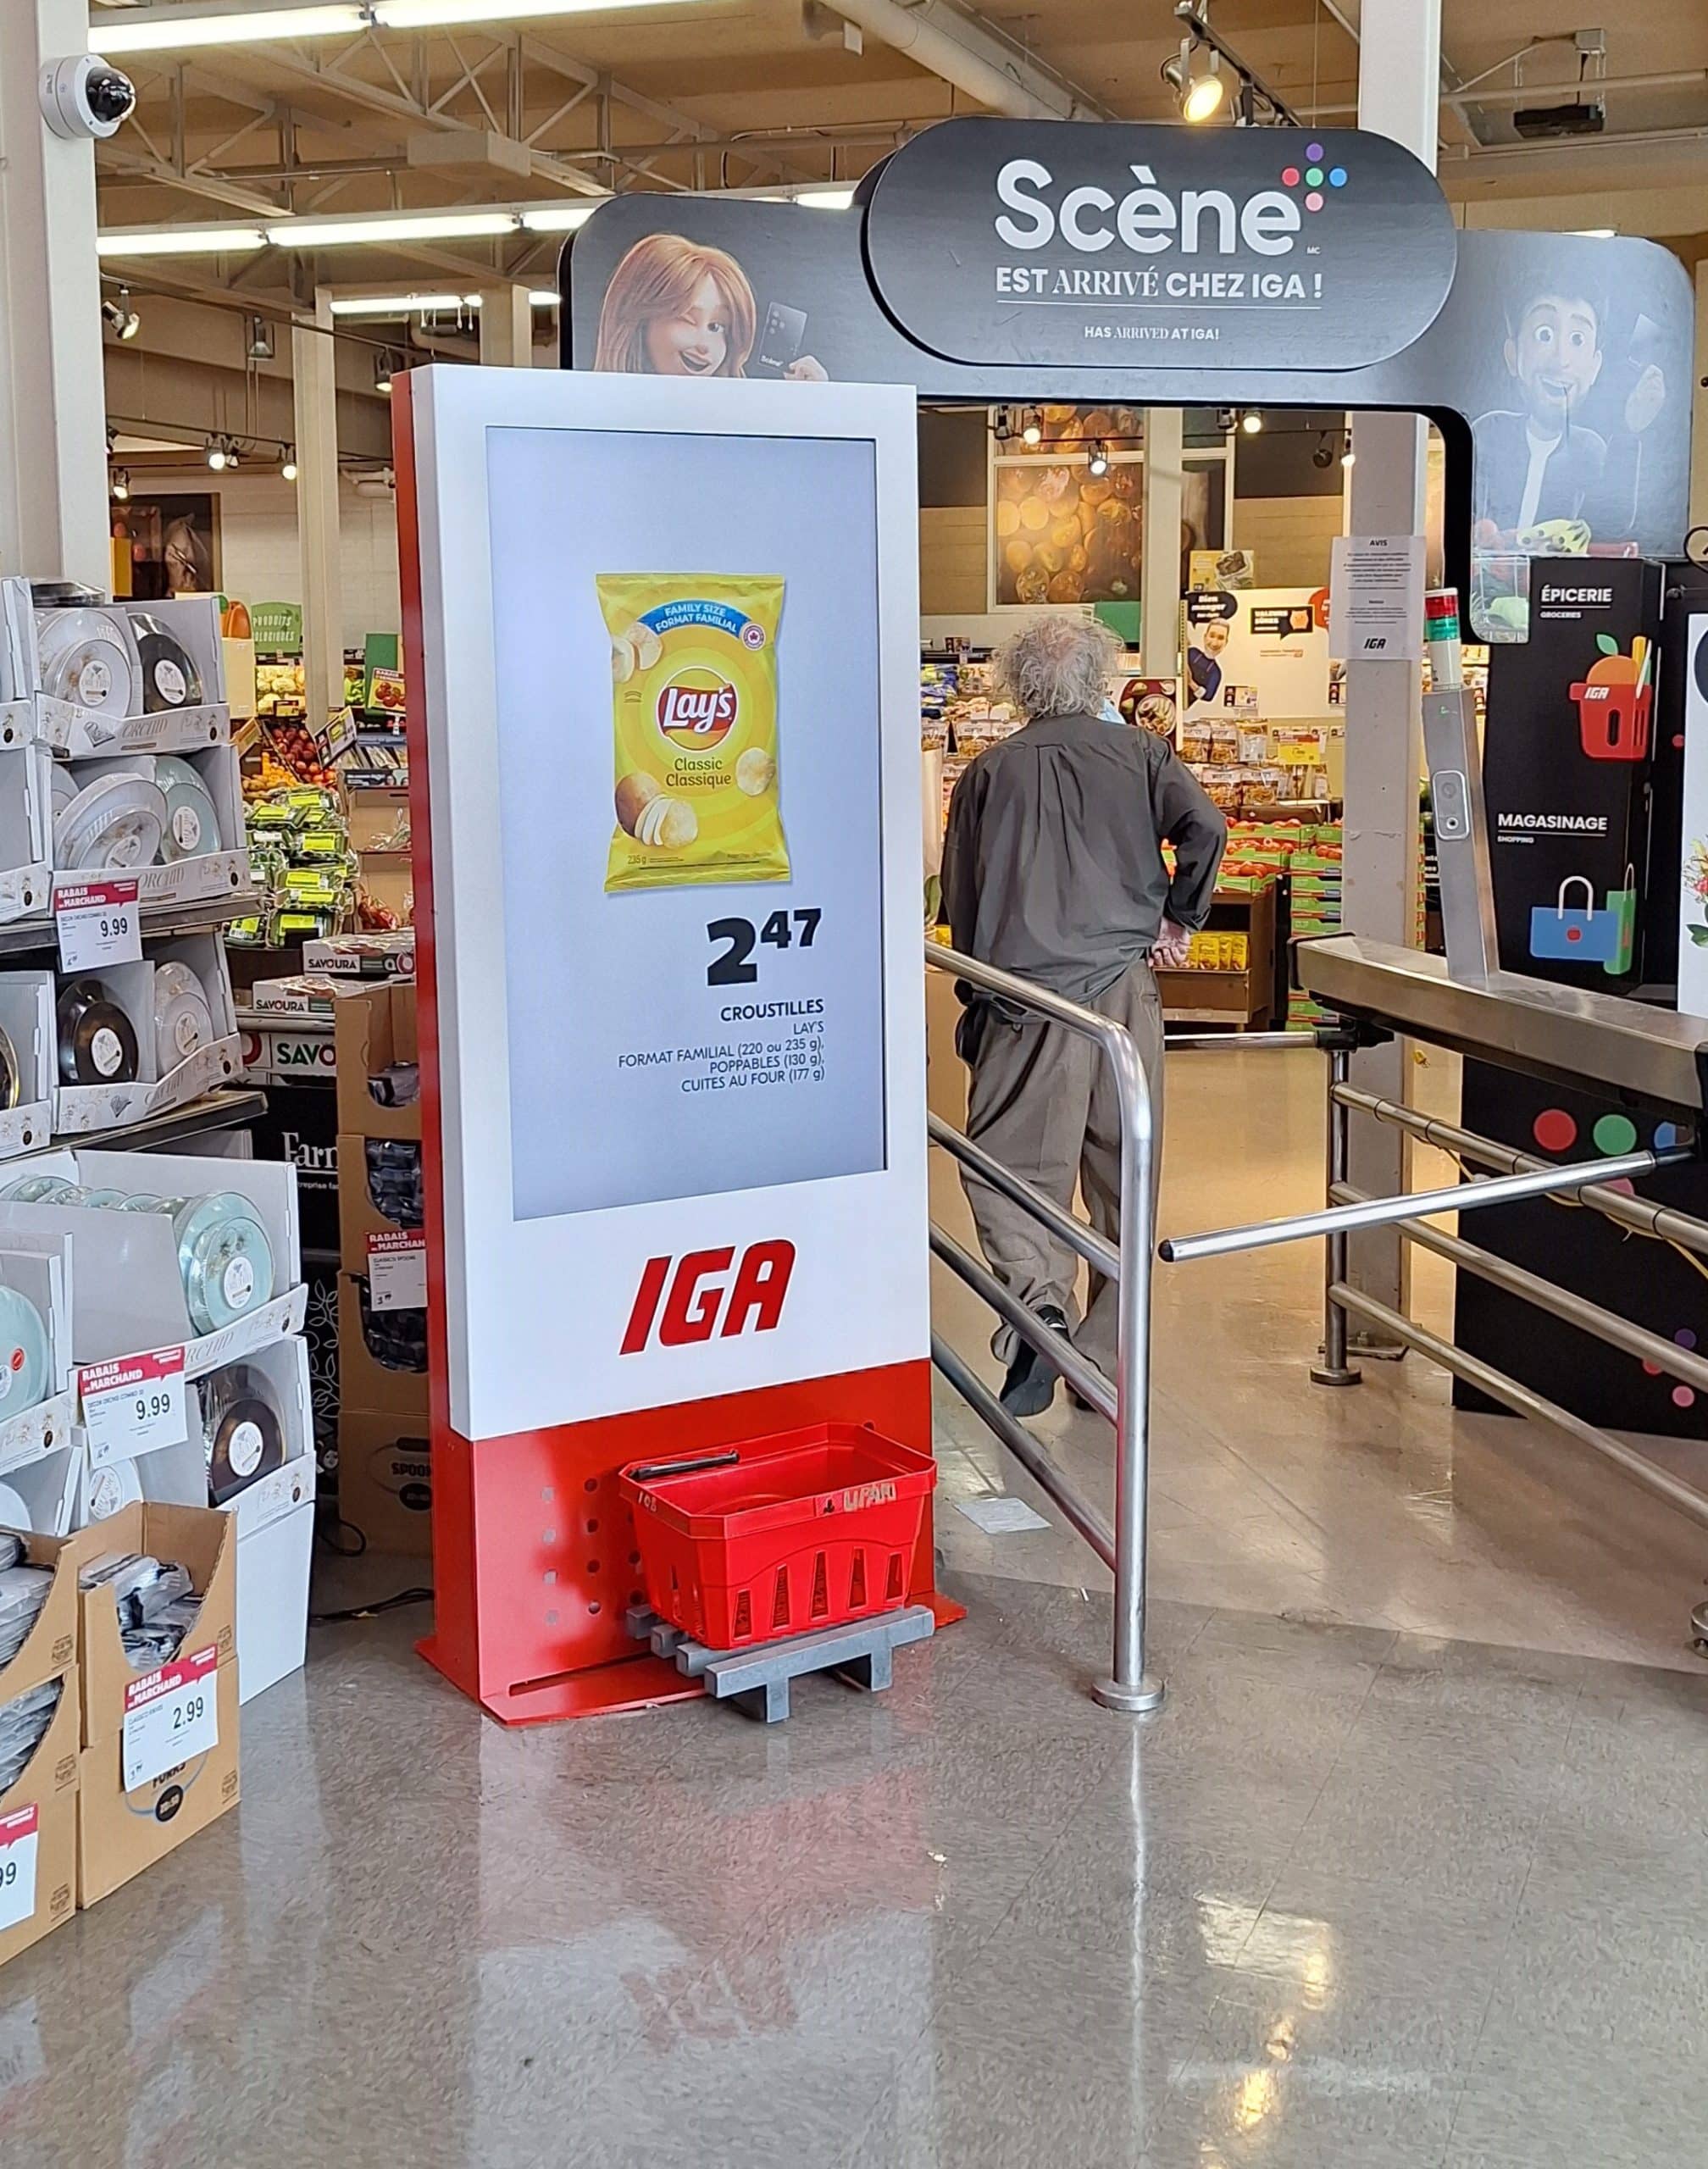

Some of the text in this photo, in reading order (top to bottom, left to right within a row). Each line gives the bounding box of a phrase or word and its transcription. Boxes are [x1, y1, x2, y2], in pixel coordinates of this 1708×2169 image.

[995, 159, 1300, 255] Scène
[995, 267, 1048, 292] EST
[1051, 265, 1159, 297] ARRIVÉ
[1166, 273, 1245, 298] CHEZ
[1084, 326, 1219, 340] HAS ARRIVED AT IGA!
[1541, 585, 1612, 602] ÉPICERIE
[664, 603, 726, 617] FAMILY SIZE
[655, 613, 737, 633] FORMAT FAMILIAL
[1363, 638, 1387, 649] IGA
[1584, 686, 1610, 700] IGA
[663, 687, 733, 733] Lay's
[674, 756, 723, 771] Classic
[666, 772, 731, 789] Classique
[1497, 813, 1608, 830] MAGASINAGE
[58, 887, 88, 899] RABAIS
[100, 917, 128, 937] 9.99
[308, 958, 357, 969] SAVOURA
[256, 1000, 304, 1011] SAVOURA
[720, 998, 824, 1022] CROUSTILLES
[793, 1020, 824, 1035] LAY'S
[618, 1050, 674, 1068] FORMAT
[677, 1044, 735, 1062] FAMILIAL
[737, 1041, 762, 1057] (220
[767, 1042, 781, 1052] ou
[785, 1038, 806, 1051] 235
[710, 1055, 780, 1073] POPPABLES
[784, 1053, 806, 1068] (130
[681, 1066, 825, 1093] CUITES AU FOUR (177 g)
[369, 1232, 408, 1243] RABAIS
[619, 1238, 796, 1356] IGA
[82, 1362, 119, 1381] RABAIS
[90, 1369, 143, 1390] MARCHAND
[136, 1394, 170, 1420] 9.99
[128, 1670, 162, 1697] RABAIS
[134, 1673, 182, 1705] MARCHAND
[173, 1696, 203, 1729] 2.99
